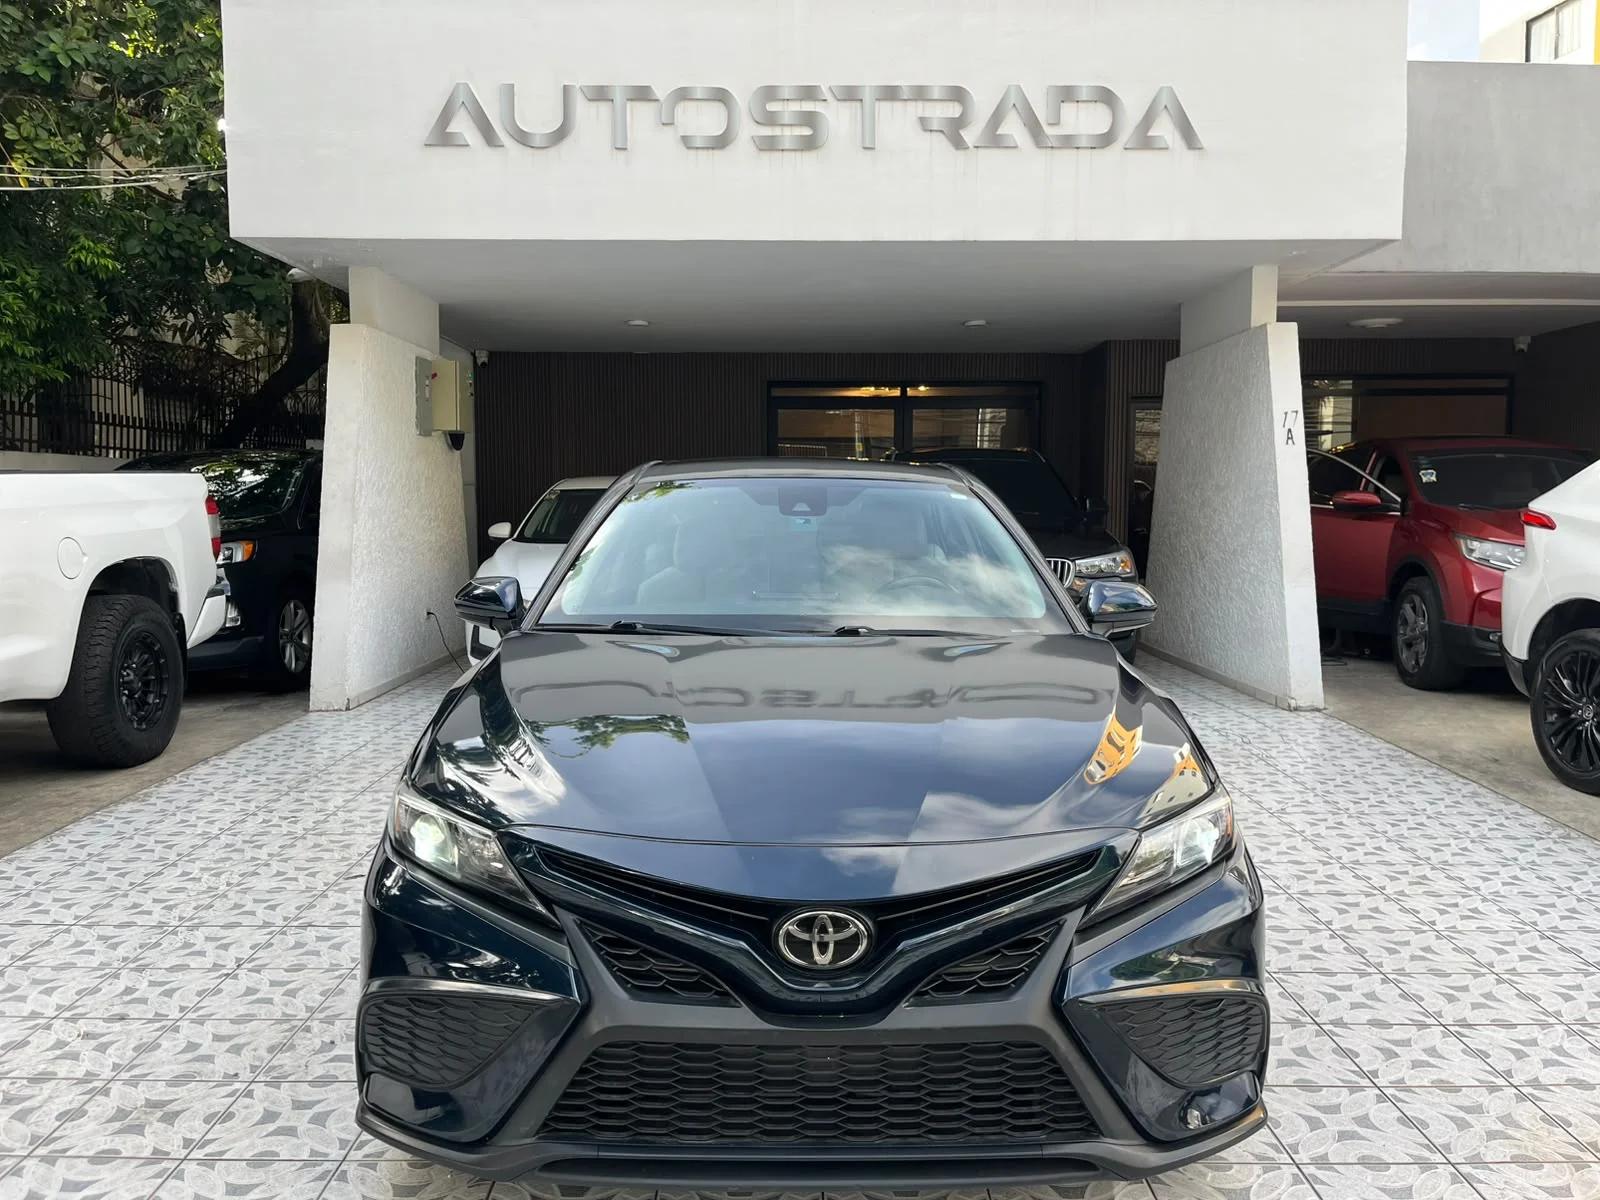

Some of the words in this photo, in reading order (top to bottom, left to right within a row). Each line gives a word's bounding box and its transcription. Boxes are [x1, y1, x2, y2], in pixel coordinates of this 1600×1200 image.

[424, 82, 1204, 150] AUTOSTRADA
[1282, 410, 1299, 428] 17
[1285, 427, 1296, 446] A
